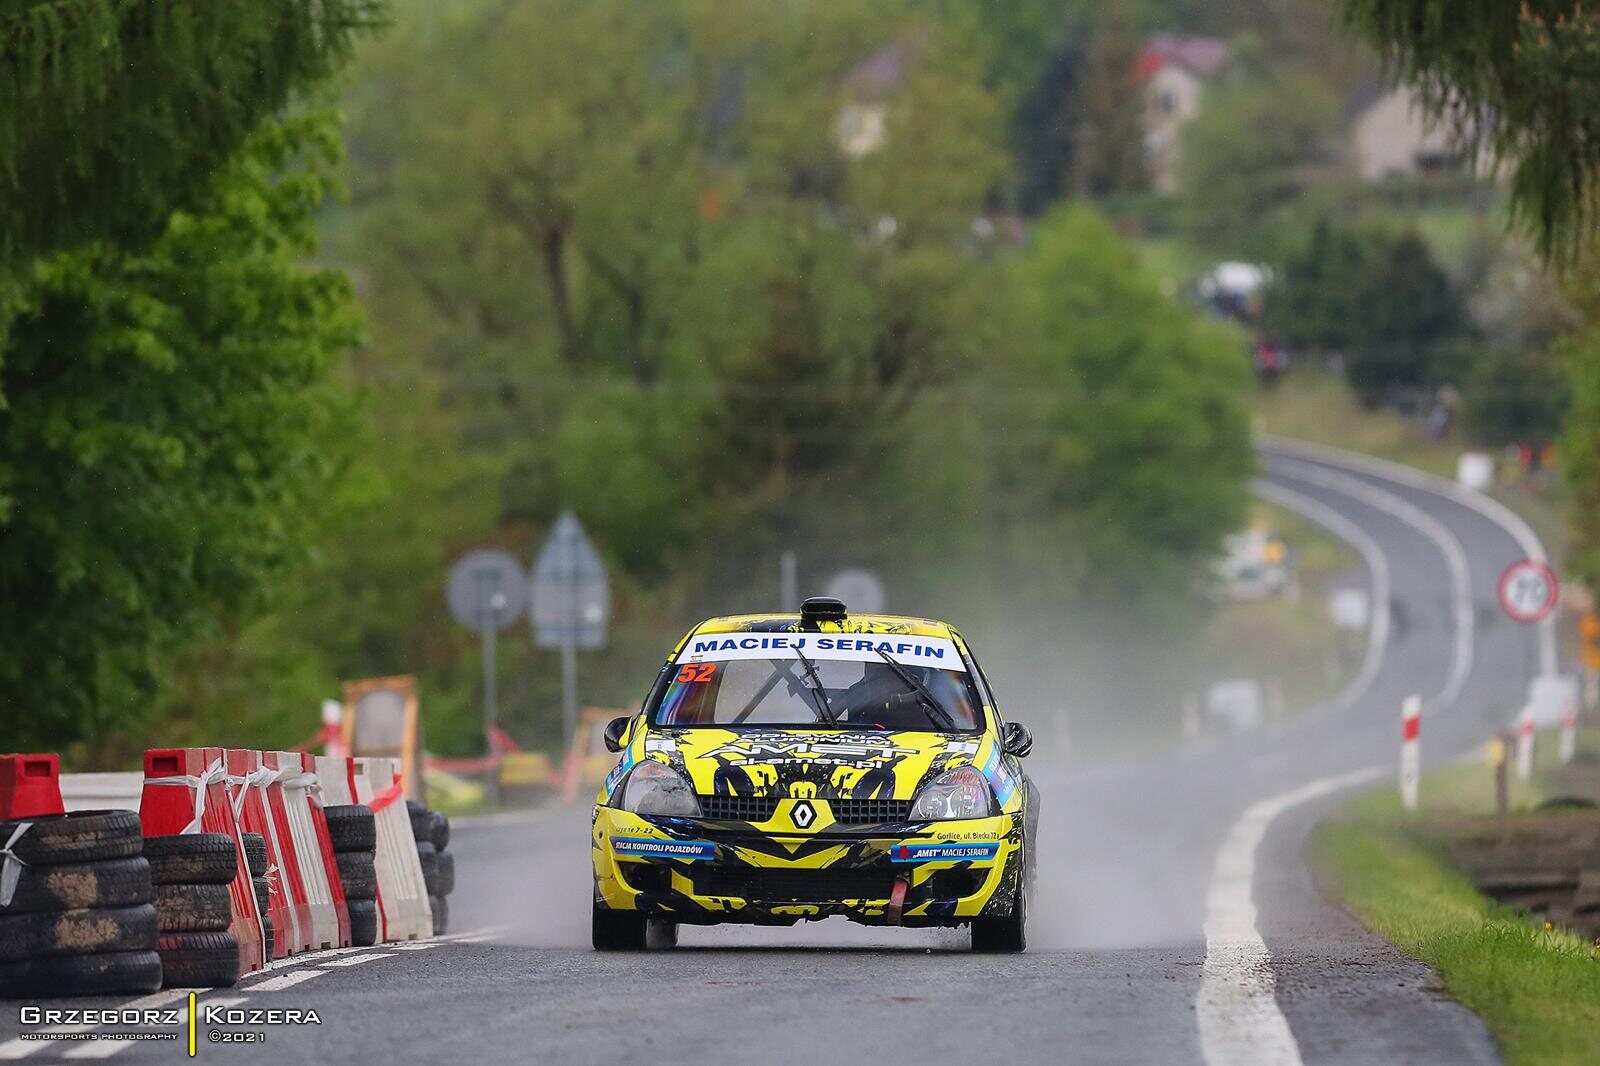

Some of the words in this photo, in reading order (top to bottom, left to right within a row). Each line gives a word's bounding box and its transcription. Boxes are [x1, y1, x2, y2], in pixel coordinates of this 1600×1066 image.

[694, 638, 806, 653] MACIEJ
[816, 638, 944, 659] SERAFIN
[678, 663, 717, 683] 52
[729, 758, 882, 769] al-amet.pl
[937, 832, 963, 840] Gorlice,
[631, 843, 665, 852] KONTROLI
[664, 844, 704, 854] POJAZDÓW
[941, 848, 967, 857] MACIEJ
[966, 848, 989, 856] SERAFIN
